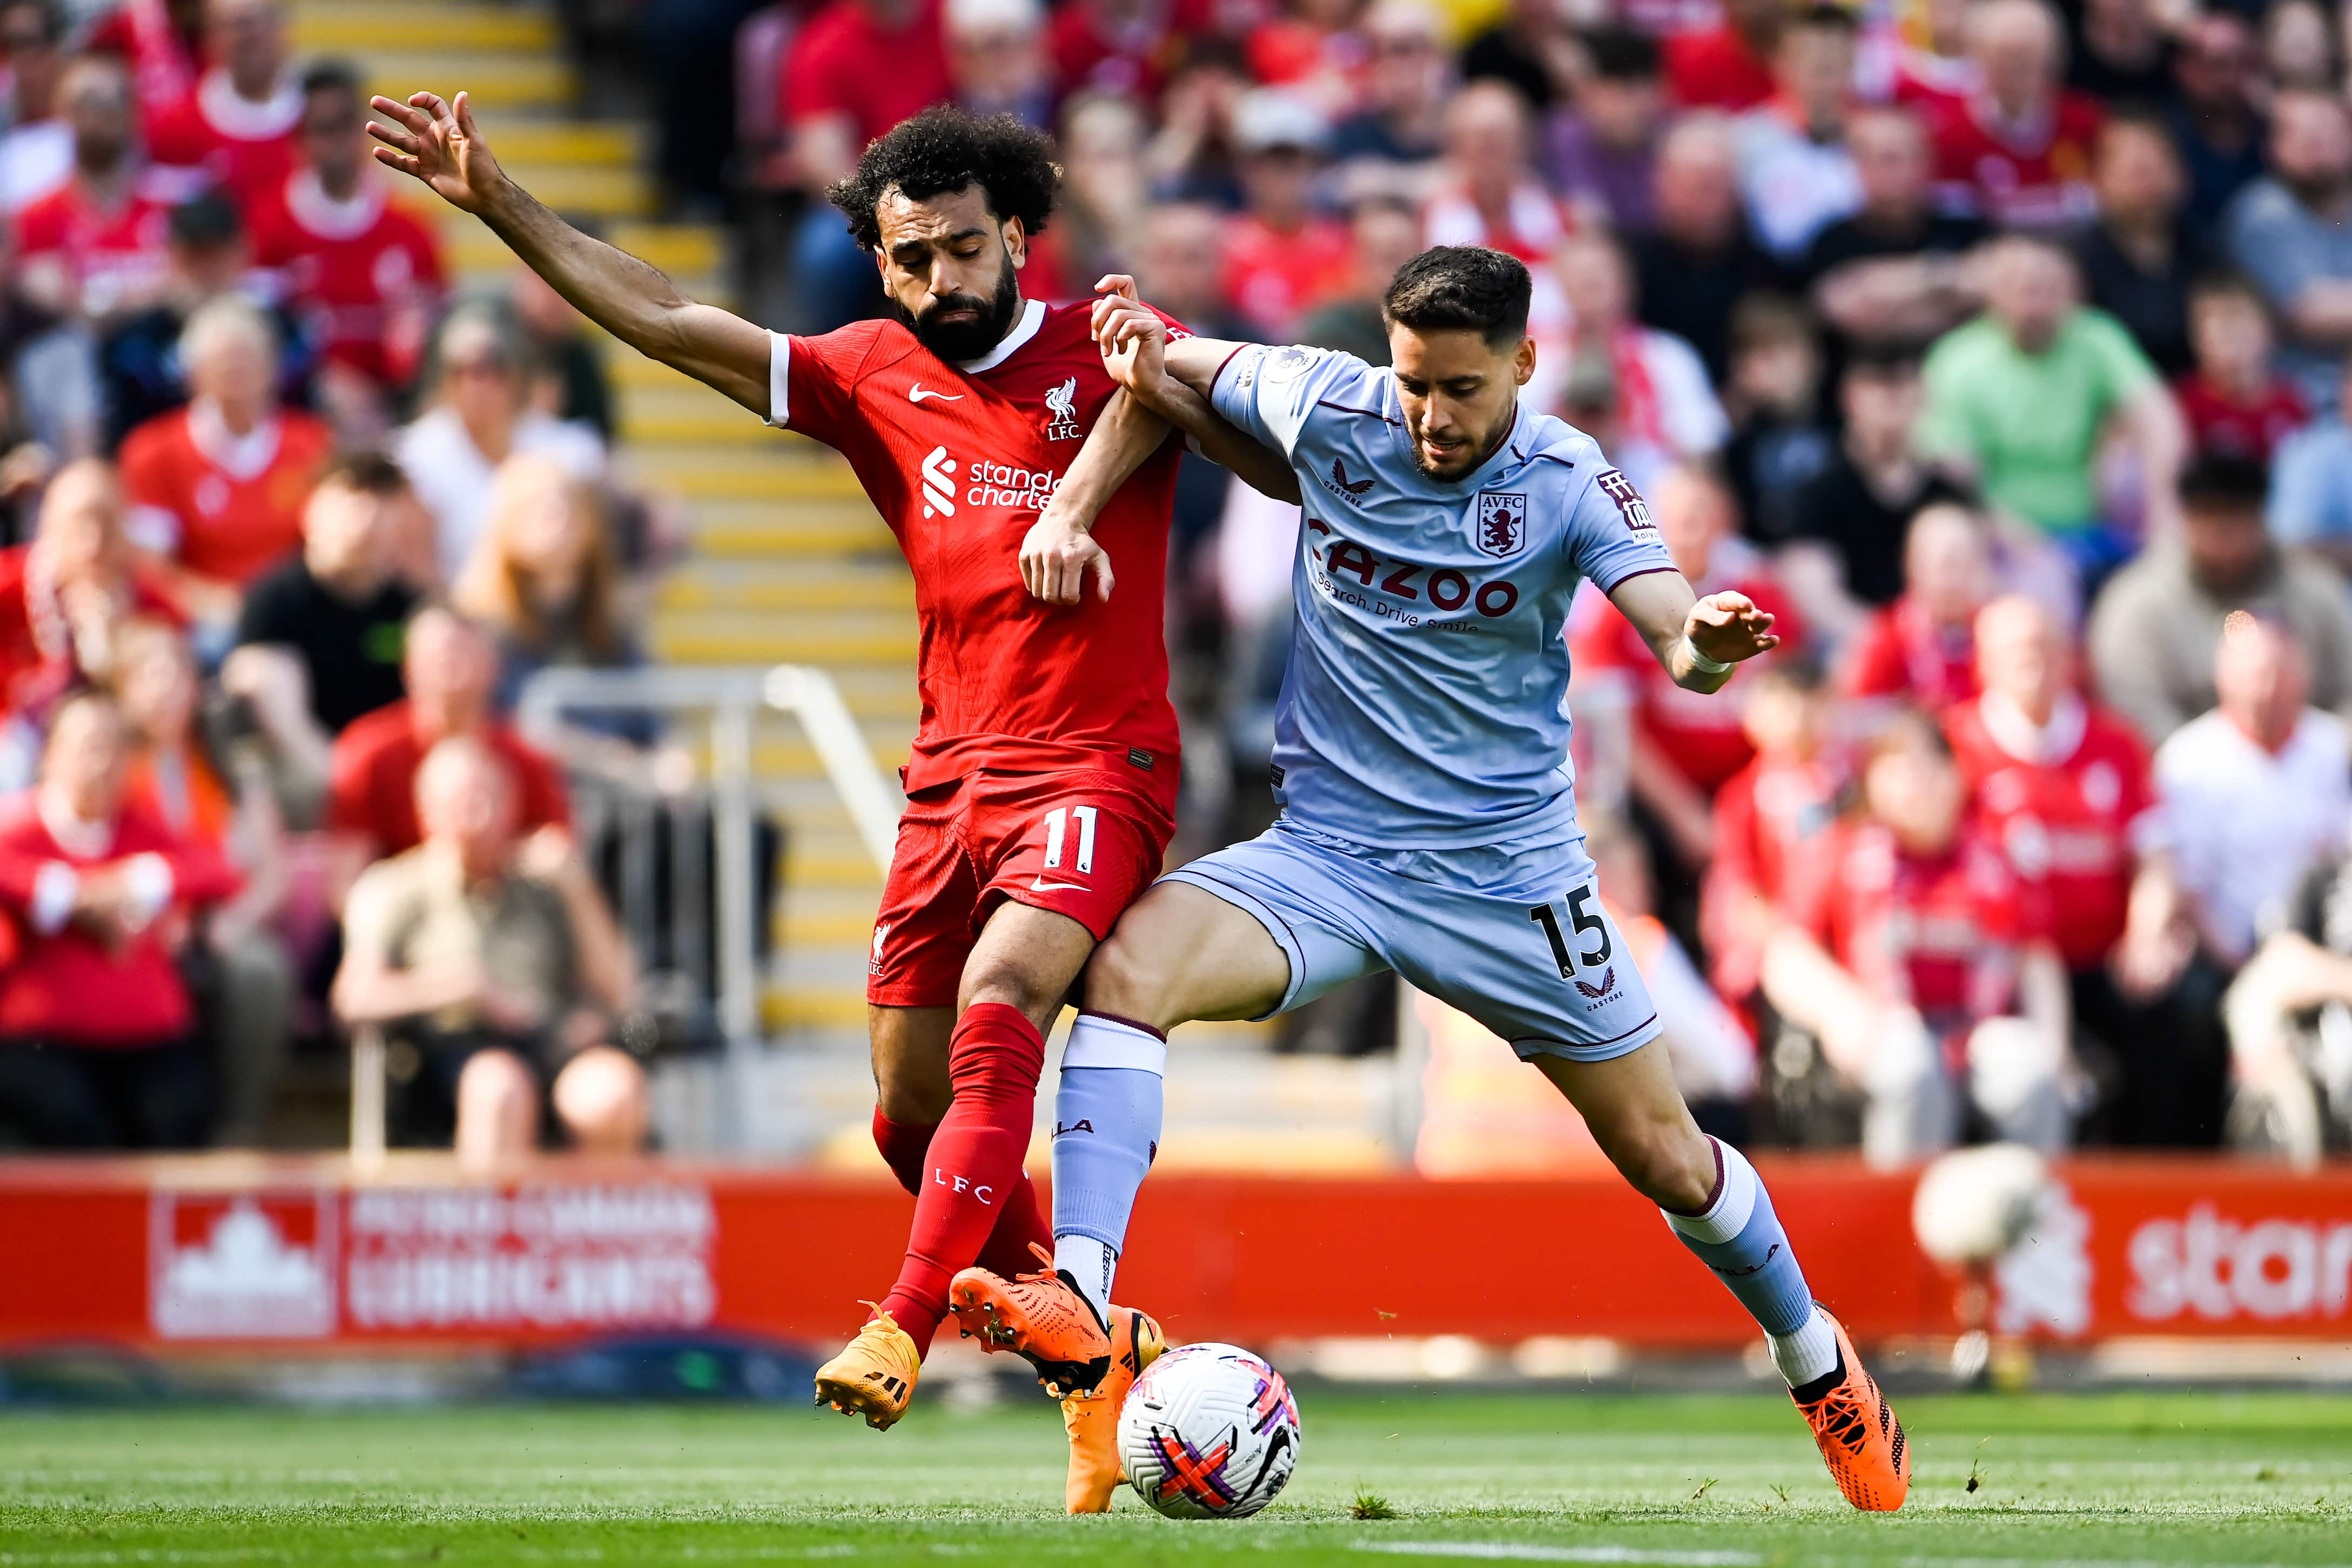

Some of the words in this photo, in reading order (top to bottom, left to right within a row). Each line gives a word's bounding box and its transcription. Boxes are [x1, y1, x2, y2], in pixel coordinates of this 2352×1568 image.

[1323, 480, 1362, 508] CASTORE
[1482, 496, 1523, 509] AVFC
[1318, 571, 1370, 611] Search.
[1375, 601, 1421, 629] Drive.
[1043, 805, 1098, 874] 11
[1529, 884, 1612, 981] 15
[1587, 990, 1624, 1012] CASTORE
